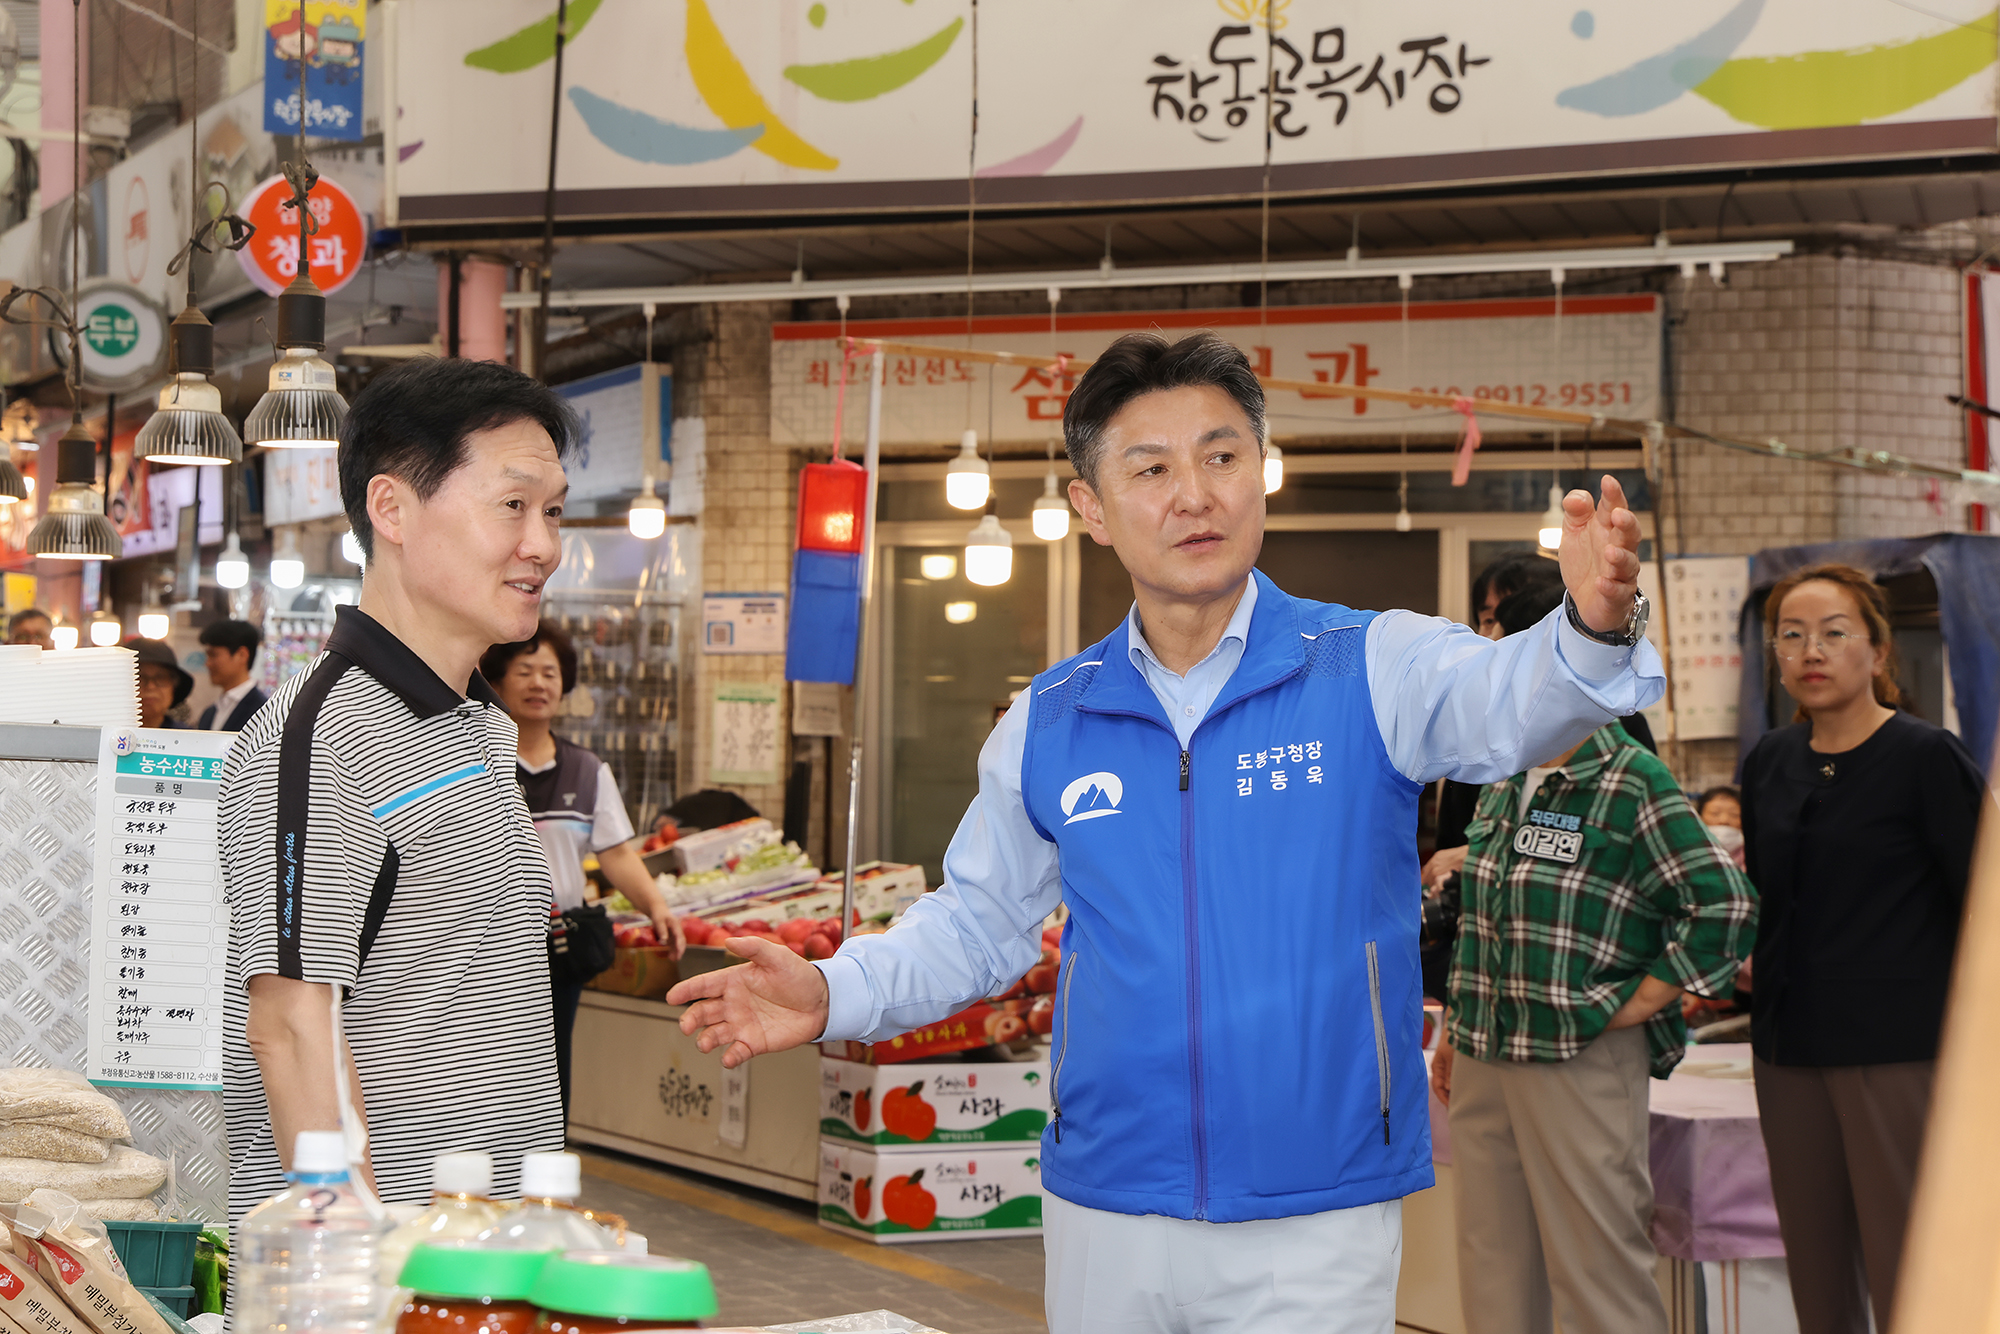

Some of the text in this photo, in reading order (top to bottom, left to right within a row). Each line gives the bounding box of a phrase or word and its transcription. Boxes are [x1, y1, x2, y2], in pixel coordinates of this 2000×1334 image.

[1146, 25, 1491, 140] 창동골목시장
[267, 233, 348, 277] 청과
[89, 314, 136, 349] 두부
[1408, 381, 1632, 411] 0109912-9551
[139, 755, 205, 778] 농수산물
[1236, 740, 1323, 770] 도봉구청장
[1529, 808, 1582, 832] 직무대행
[1515, 826, 1582, 861] 이길연
[197, 1072, 219, 1082] 수산물
[959, 1097, 1006, 1119] 사과
[959, 1183, 1006, 1206] 사과
[84, 1283, 144, 1334] 메밀부침가
